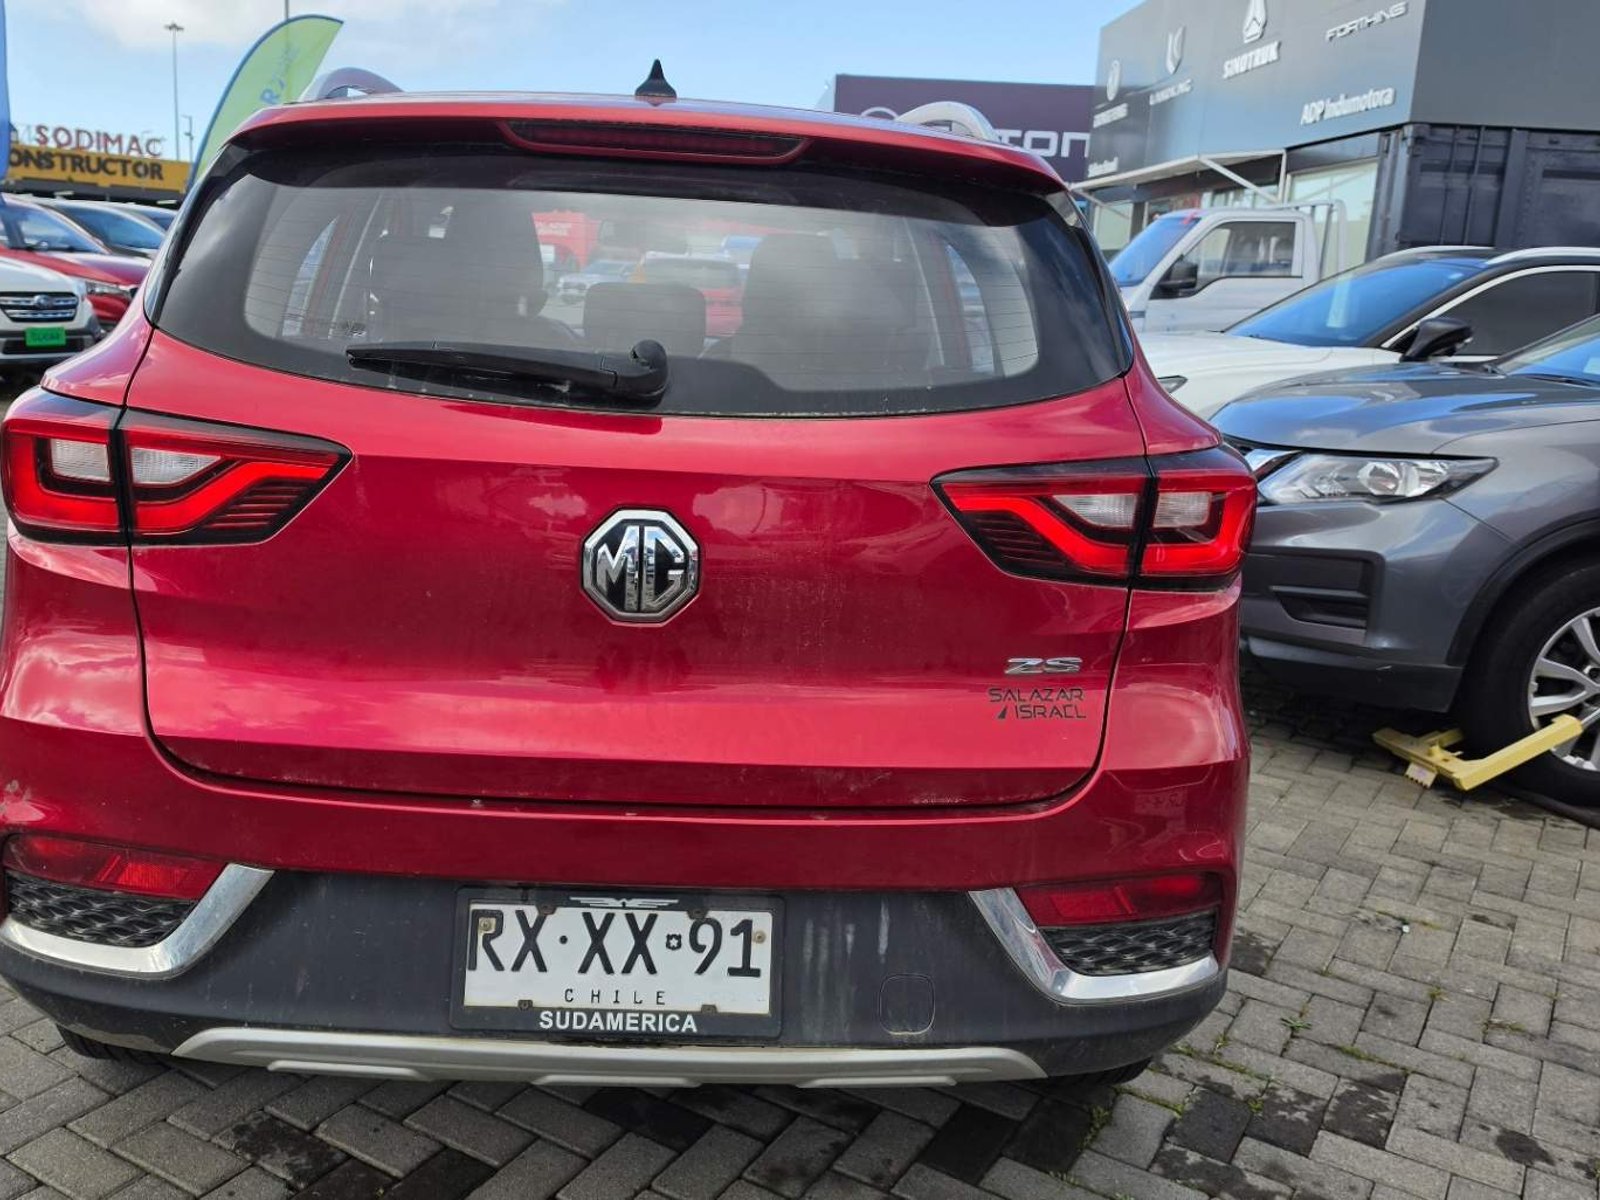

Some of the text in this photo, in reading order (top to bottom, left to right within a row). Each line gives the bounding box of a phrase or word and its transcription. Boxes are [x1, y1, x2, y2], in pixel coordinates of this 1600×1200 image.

[1325, 1, 1409, 42] FORTHING
[34, 123, 163, 158] SODIMAC
[596, 524, 687, 613] MG
[1004, 656, 1084, 675] ZS
[988, 687, 1084, 703] SALAZAR
[563, 987, 667, 1006] CHILE
[538, 1010, 699, 1033] SUDAMERICA
